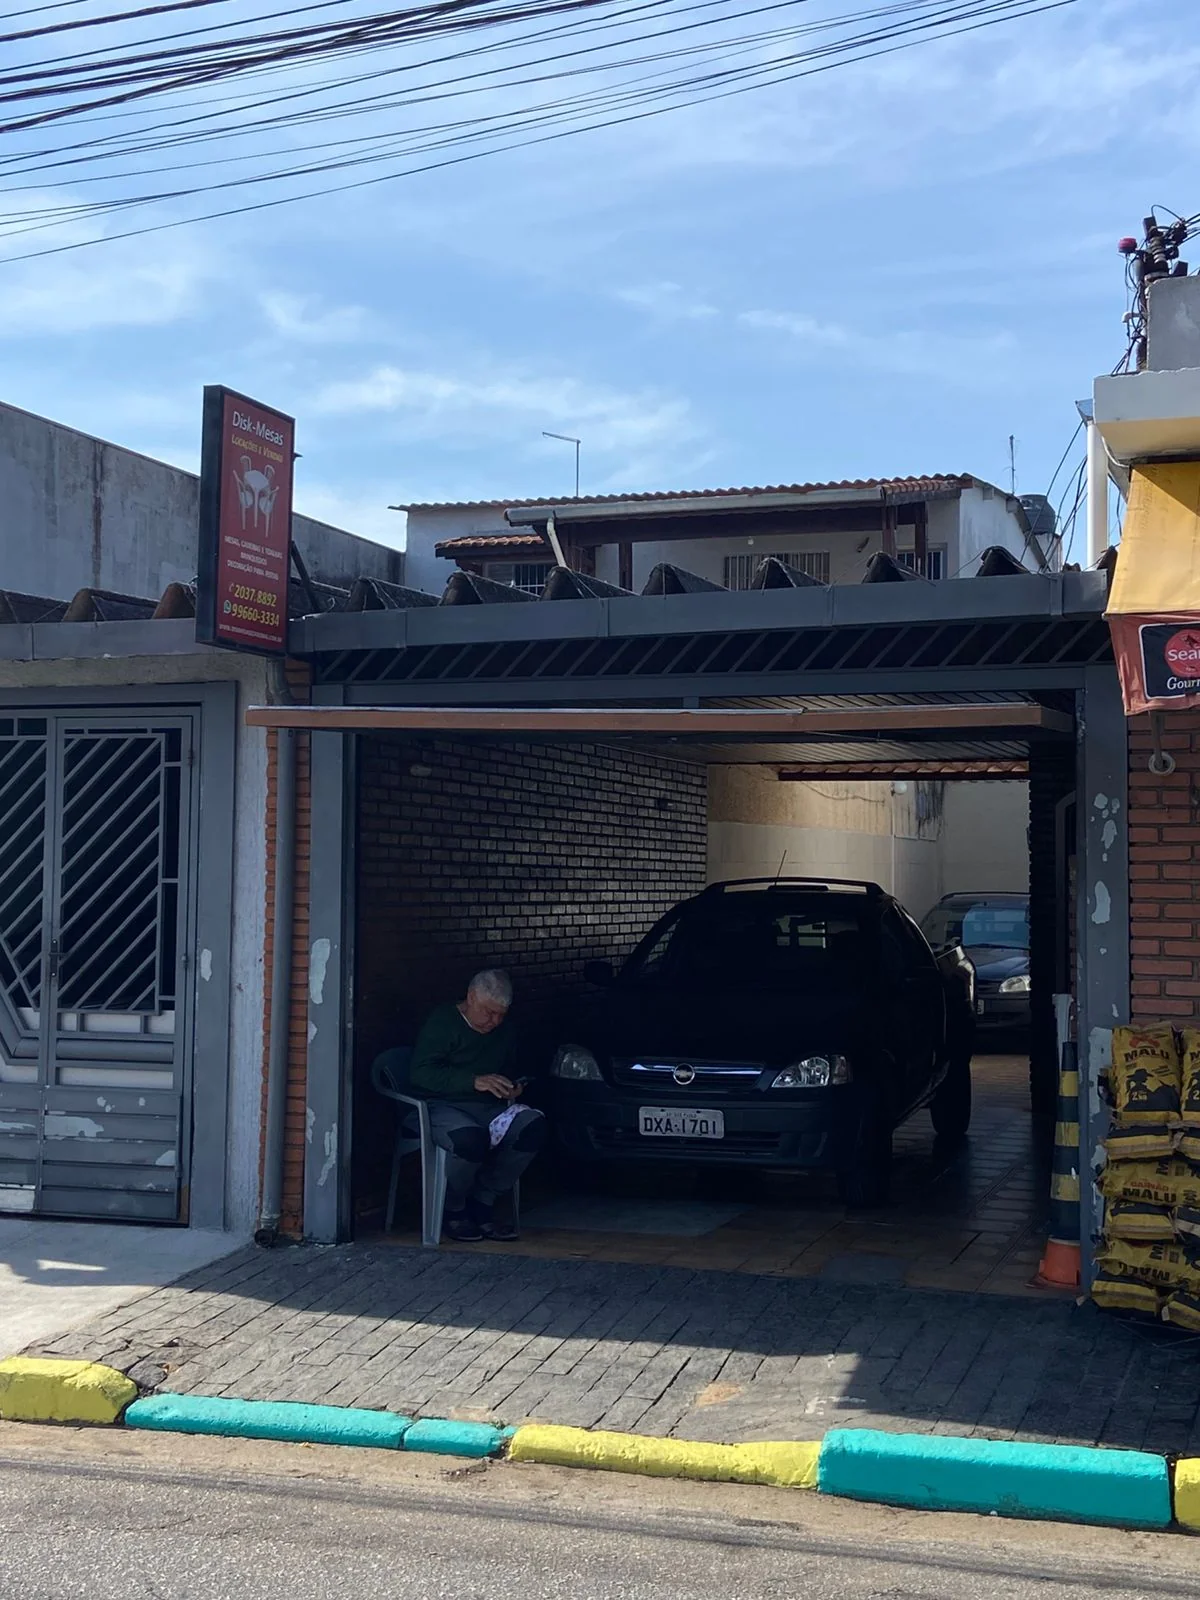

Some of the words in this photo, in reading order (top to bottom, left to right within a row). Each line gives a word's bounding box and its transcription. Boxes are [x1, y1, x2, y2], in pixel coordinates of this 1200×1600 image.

[232, 411, 284, 446] Disk-Mesas
[1123, 1048, 1170, 1062] MALU
[1122, 1187, 1177, 1203] MALU
